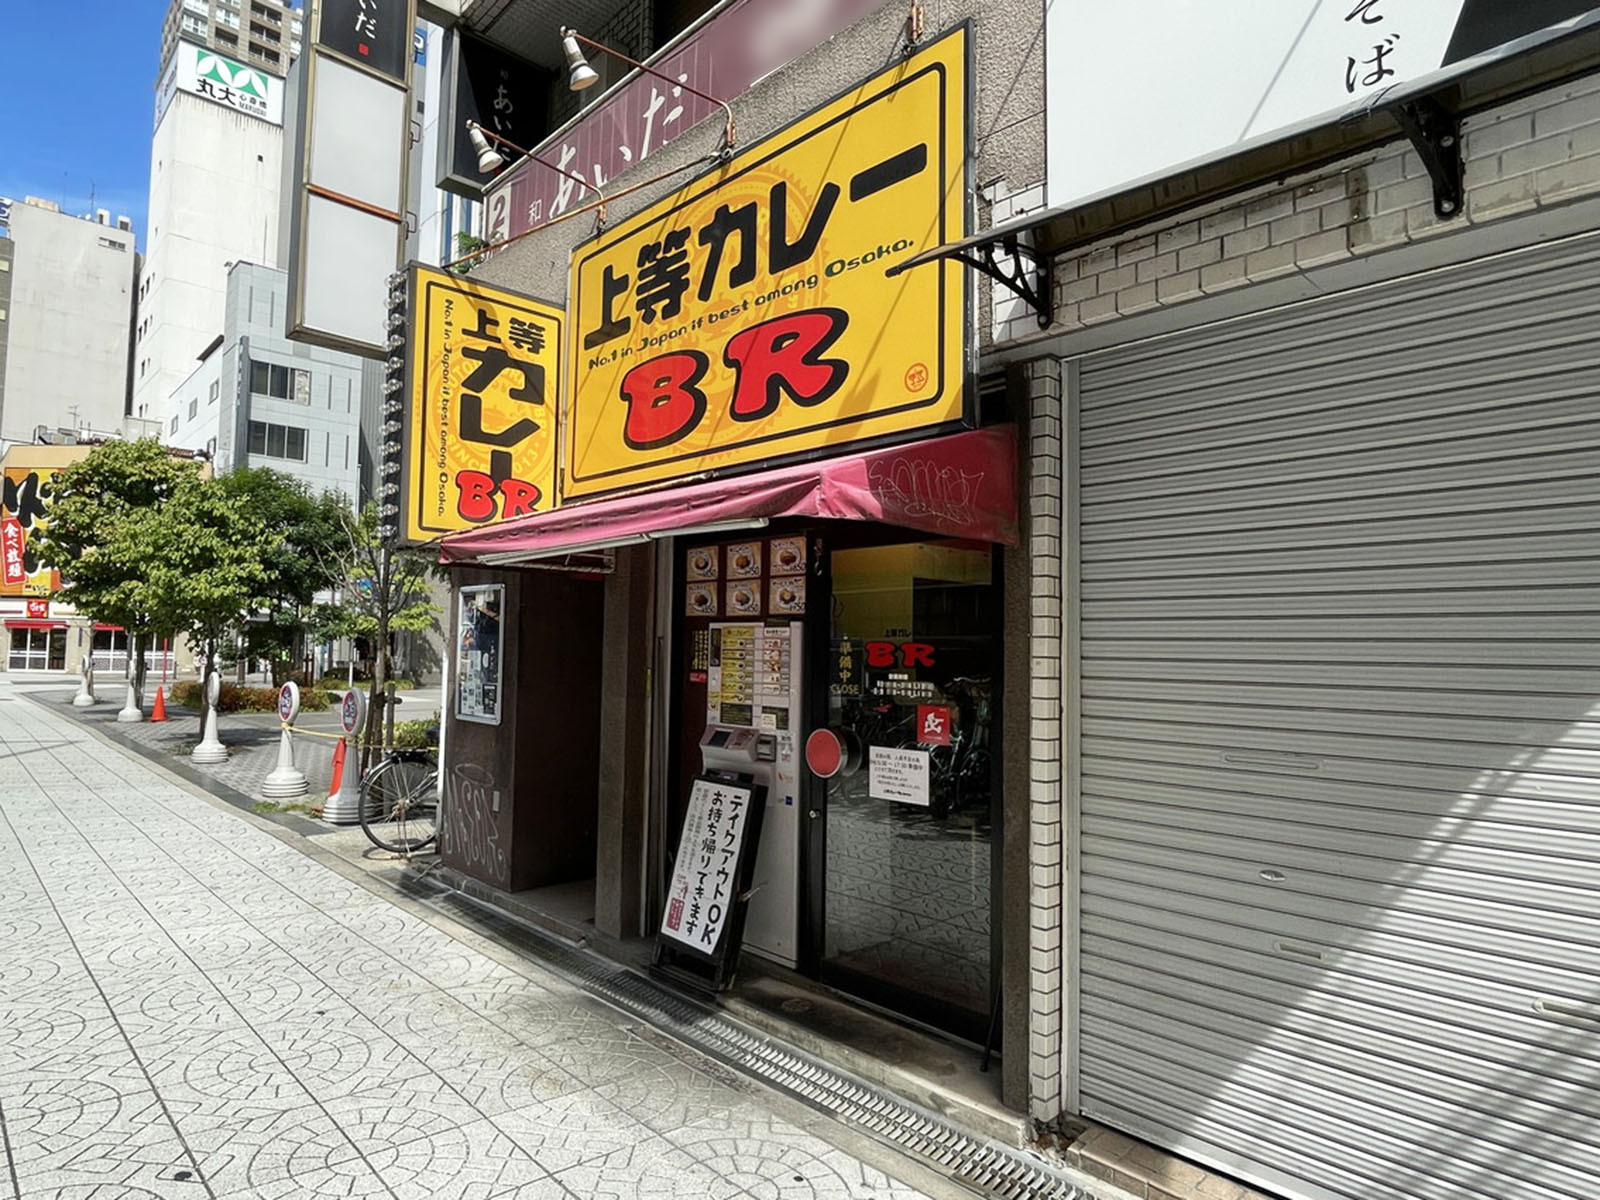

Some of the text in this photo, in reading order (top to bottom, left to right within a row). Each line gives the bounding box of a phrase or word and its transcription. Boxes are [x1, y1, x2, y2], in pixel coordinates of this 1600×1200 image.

[195, 78, 236, 106] 丸大
[583, 142, 927, 351] 上等カレー
[444, 299, 454, 327] No.1
[588, 239, 915, 370] No.1 in Japan if best among Osaka.
[443, 328, 453, 341] in
[460, 308, 546, 355] 上等
[441, 343, 453, 379] Japan
[619, 307, 850, 451] BR
[440, 381, 451, 396] if
[439, 397, 450, 427] best
[456, 470, 543, 523] BR
[865, 641, 936, 668] BR
[830, 684, 860, 695] CLOSE
[684, 790, 728, 937] お持ち帰りできます
[700, 794, 744, 946] テイクアウトOK
